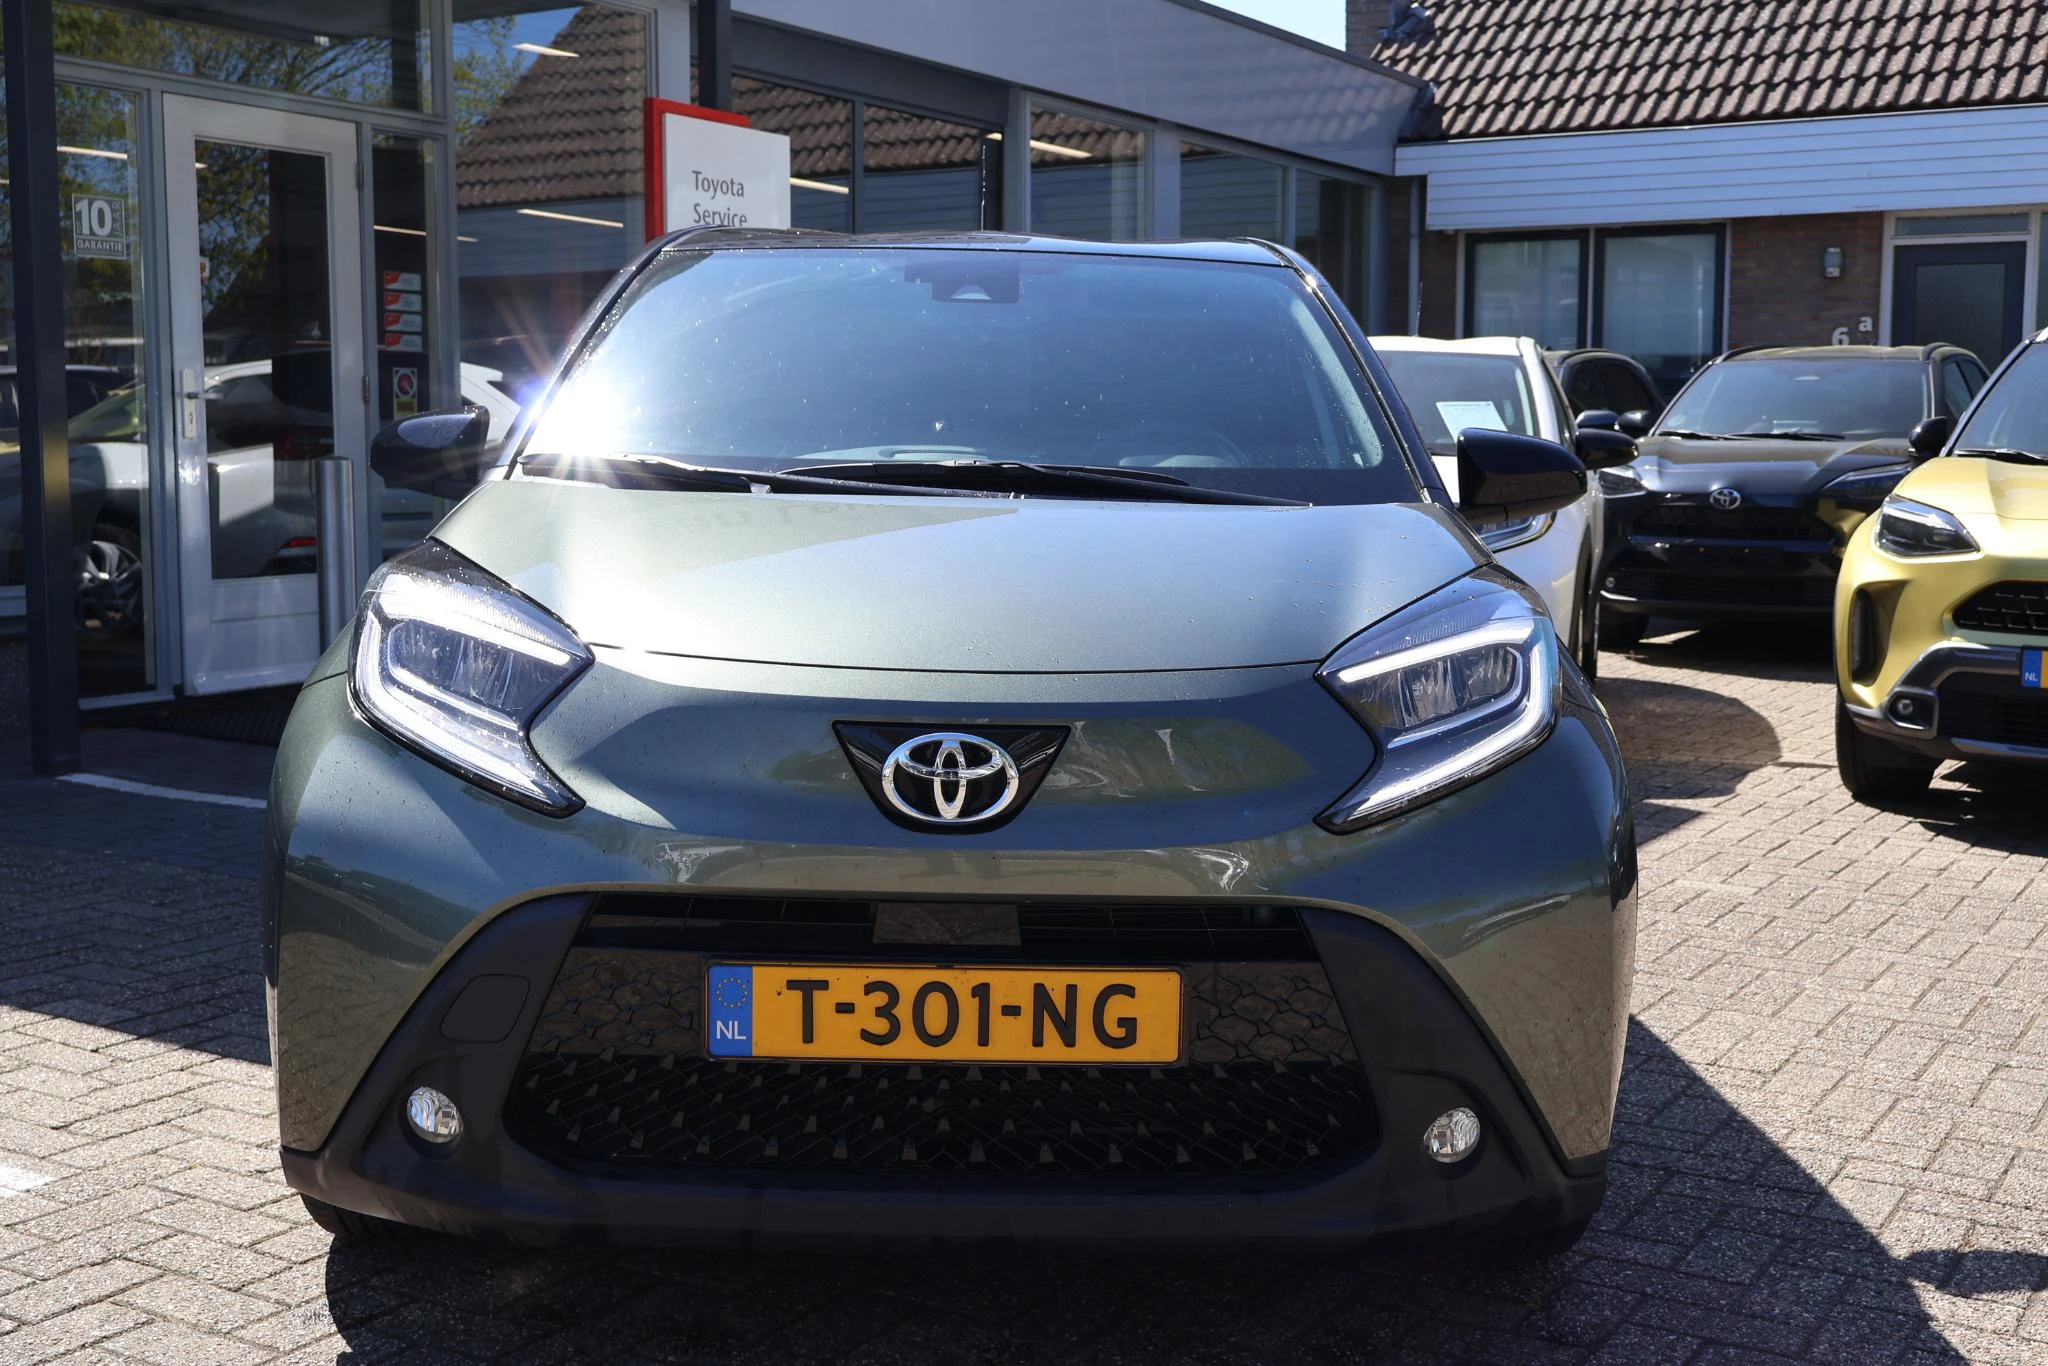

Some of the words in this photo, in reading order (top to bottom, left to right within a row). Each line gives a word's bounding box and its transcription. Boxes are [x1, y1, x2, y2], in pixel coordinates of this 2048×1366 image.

[691, 170, 745, 200] Toyota
[75, 198, 112, 237] 10
[693, 203, 748, 227] Service
[76, 239, 123, 252] GARANTIE
[2024, 671, 2039, 682] NL
[786, 979, 1138, 1049] T-301-NG
[716, 1020, 747, 1040] NL
